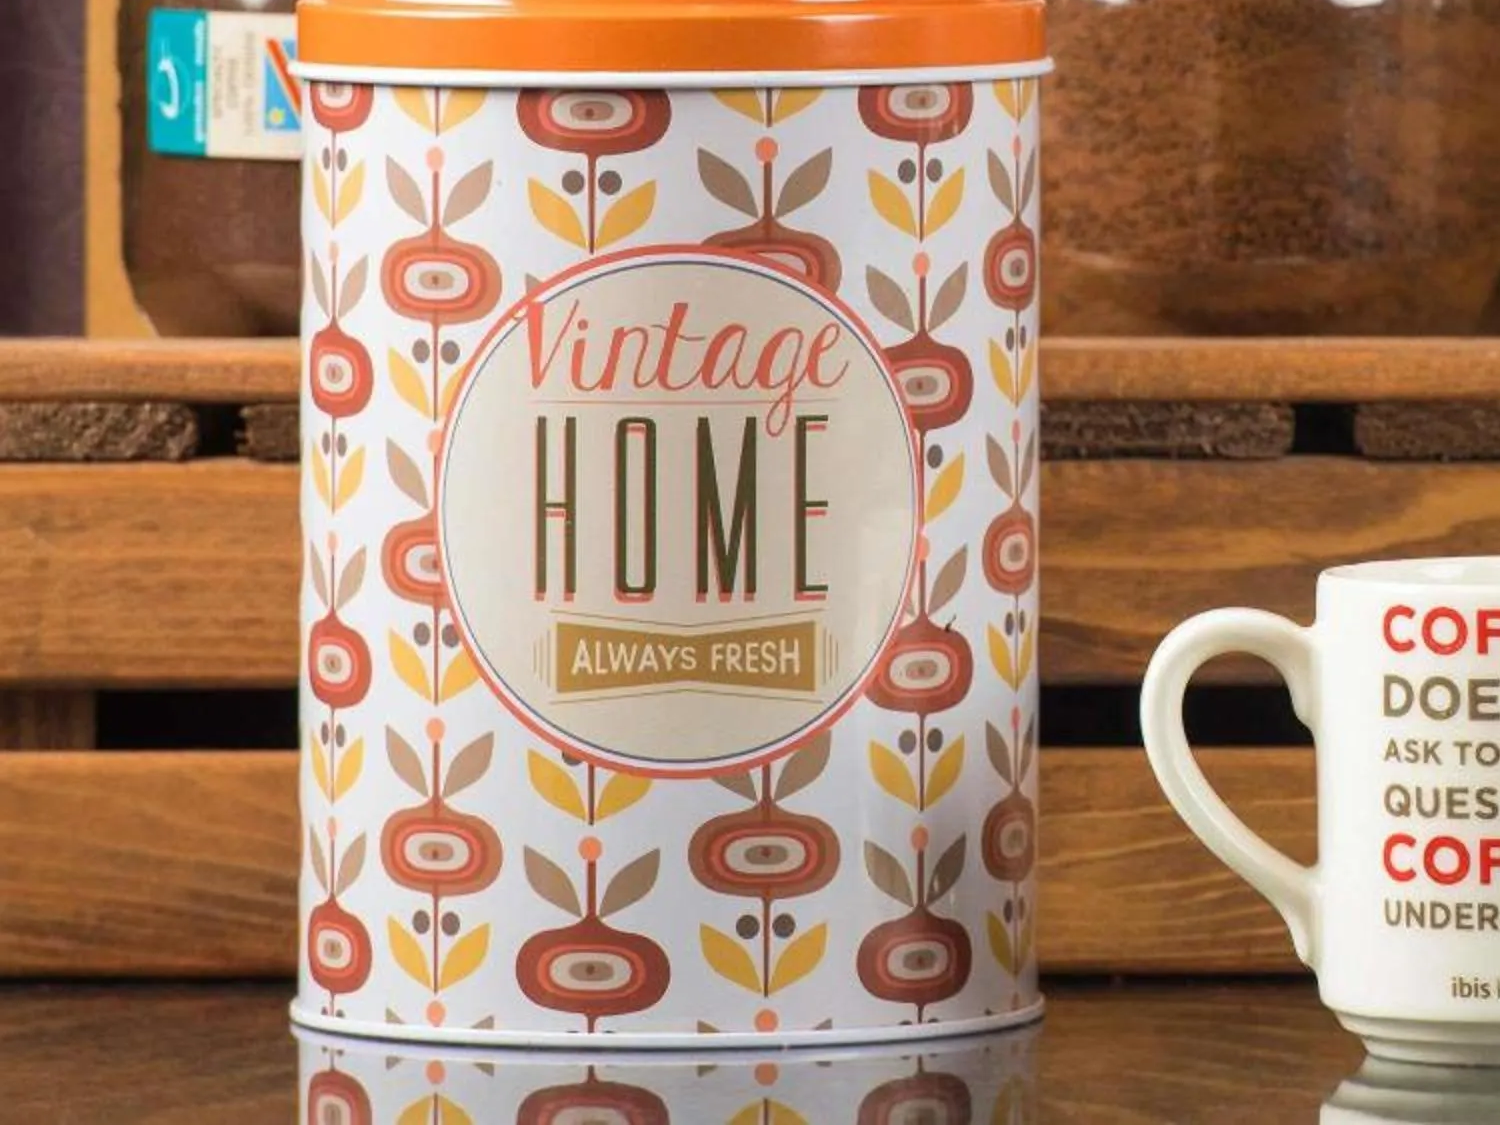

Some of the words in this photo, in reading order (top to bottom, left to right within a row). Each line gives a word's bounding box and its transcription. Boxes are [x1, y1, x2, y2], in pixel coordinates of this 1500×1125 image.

[516, 299, 849, 437] Vintage
[534, 415, 829, 602] HOME
[571, 639, 697, 675] ALWAYS
[711, 639, 800, 674] FRESH
[1384, 738, 1442, 764] ASK
[1451, 977, 1491, 999] ibis
